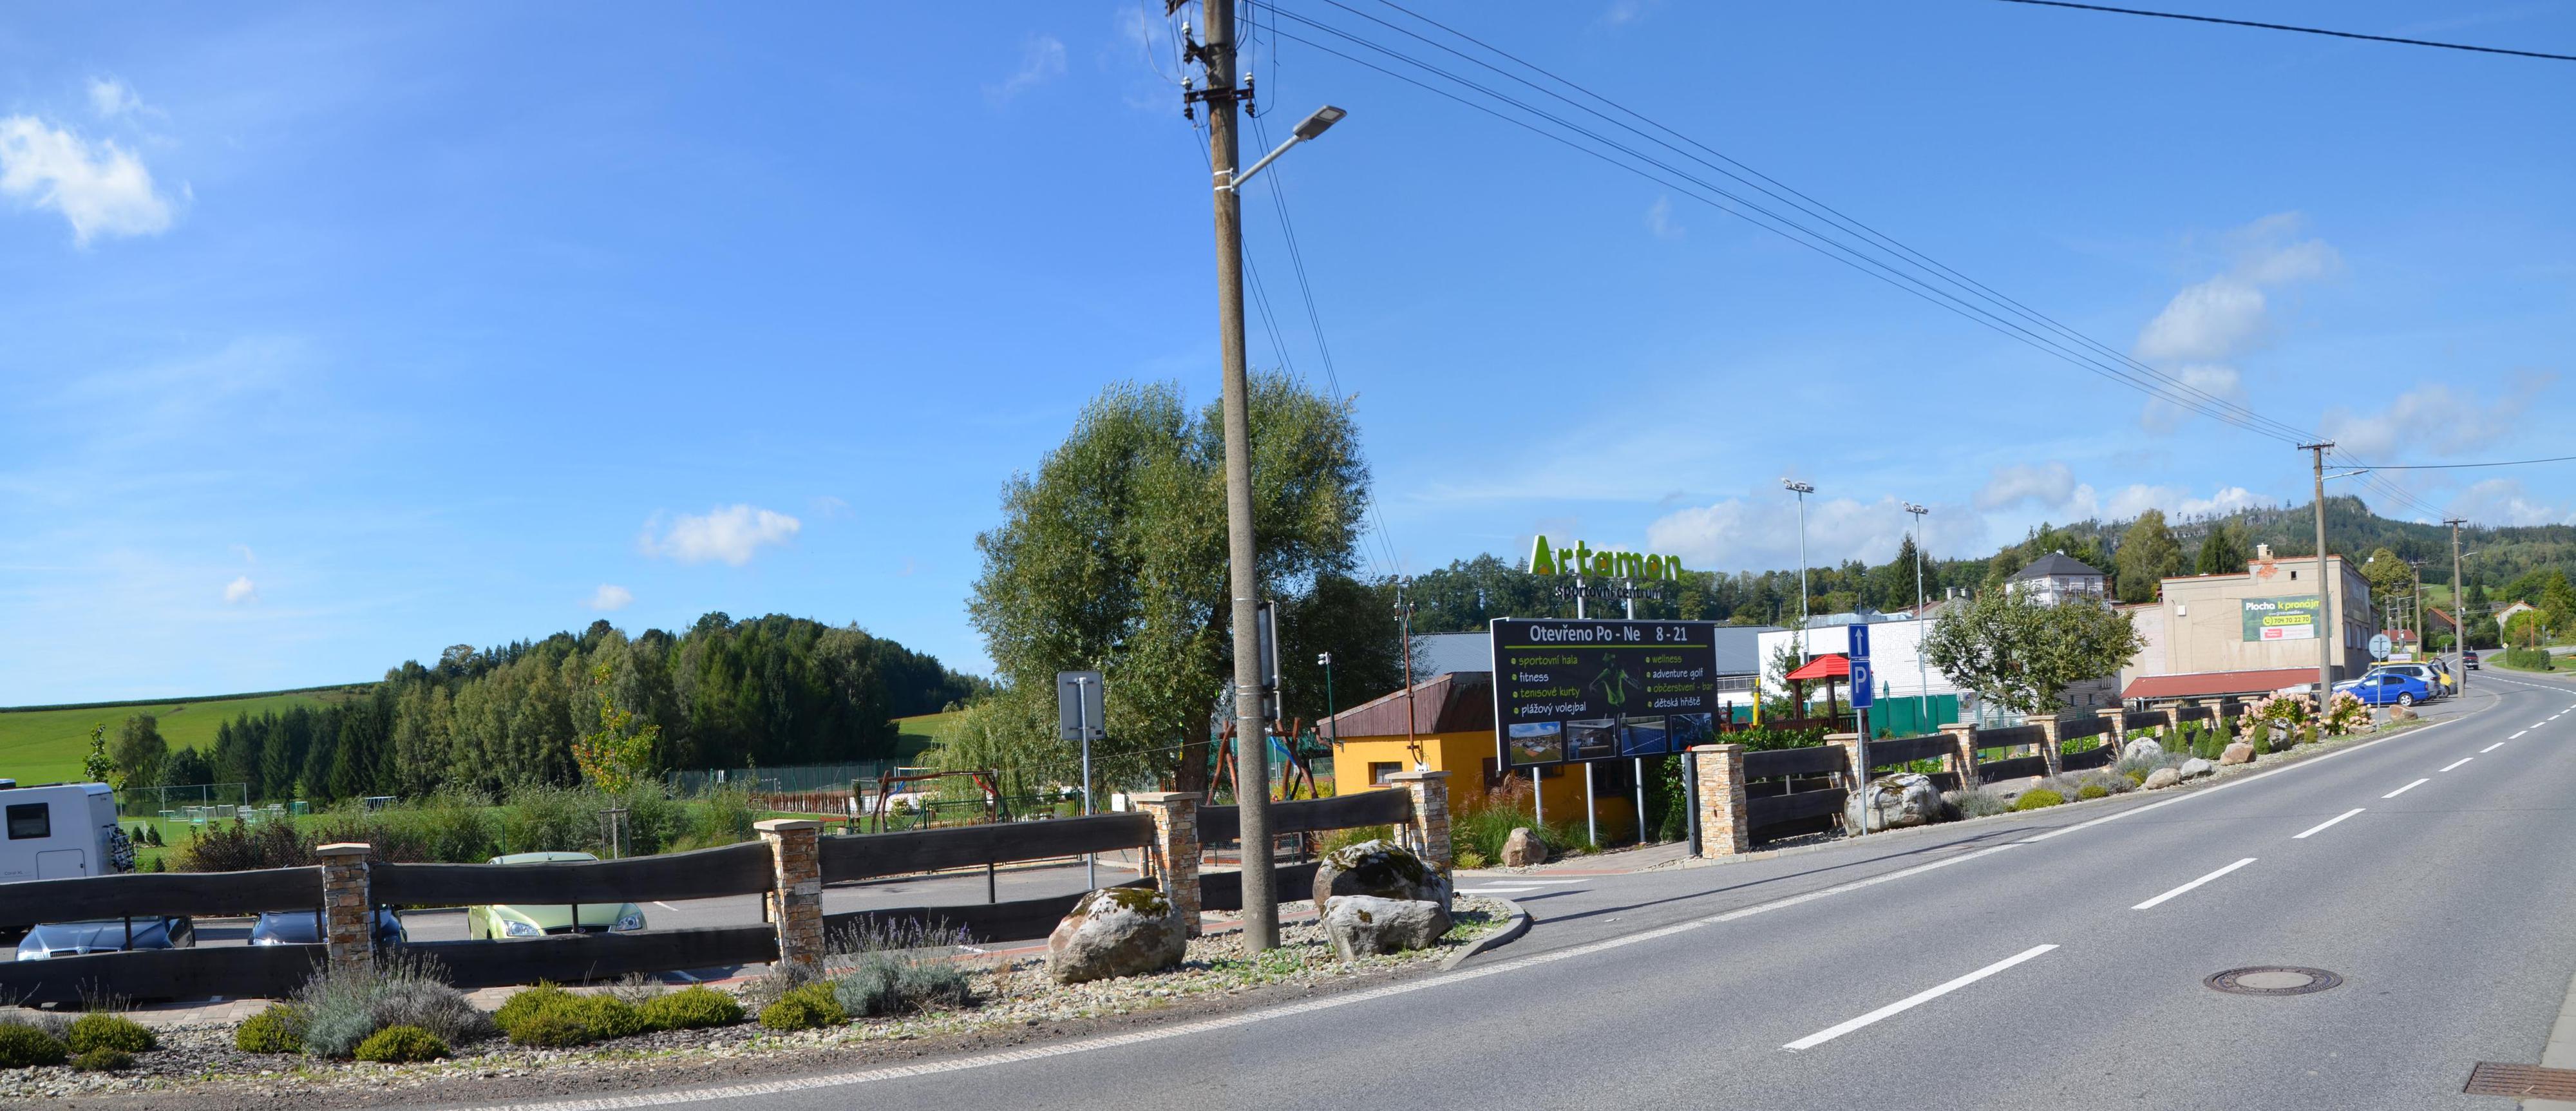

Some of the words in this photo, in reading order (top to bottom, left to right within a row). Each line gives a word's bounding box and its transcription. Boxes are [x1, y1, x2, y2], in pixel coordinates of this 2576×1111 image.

[1528, 535, 1681, 580] Artamon
[1556, 584, 1613, 600] sportovní
[1616, 585, 1661, 599] centrum
[2246, 602, 2275, 611] Plocha
[2285, 599, 2320, 611] pronájm
[1530, 624, 1593, 641] Otevřeno
[1596, 625, 1613, 641] Po
[1624, 626, 1640, 641] Ne
[1656, 627, 1663, 641] 8
[1674, 627, 1687, 641] 21
[1519, 655, 1559, 668] sportovní
[1562, 655, 1578, 665] hala
[1652, 654, 1682, 663] wellness
[1520, 672, 1549, 682] fitness
[1653, 669, 1687, 678] adventure
[1690, 668, 1703, 680] golf
[1855, 667, 1866, 693] P
[1520, 687, 1557, 698] tenisové
[1560, 686, 1580, 698] kurty
[1653, 683, 1695, 692] občerstvení
[1702, 682, 1713, 690] bar
[1654, 698, 1678, 708] dětská
[1680, 696, 1701, 706] hřiště
[1521, 703, 1553, 717] plážový
[1555, 701, 1586, 715] volejbal
